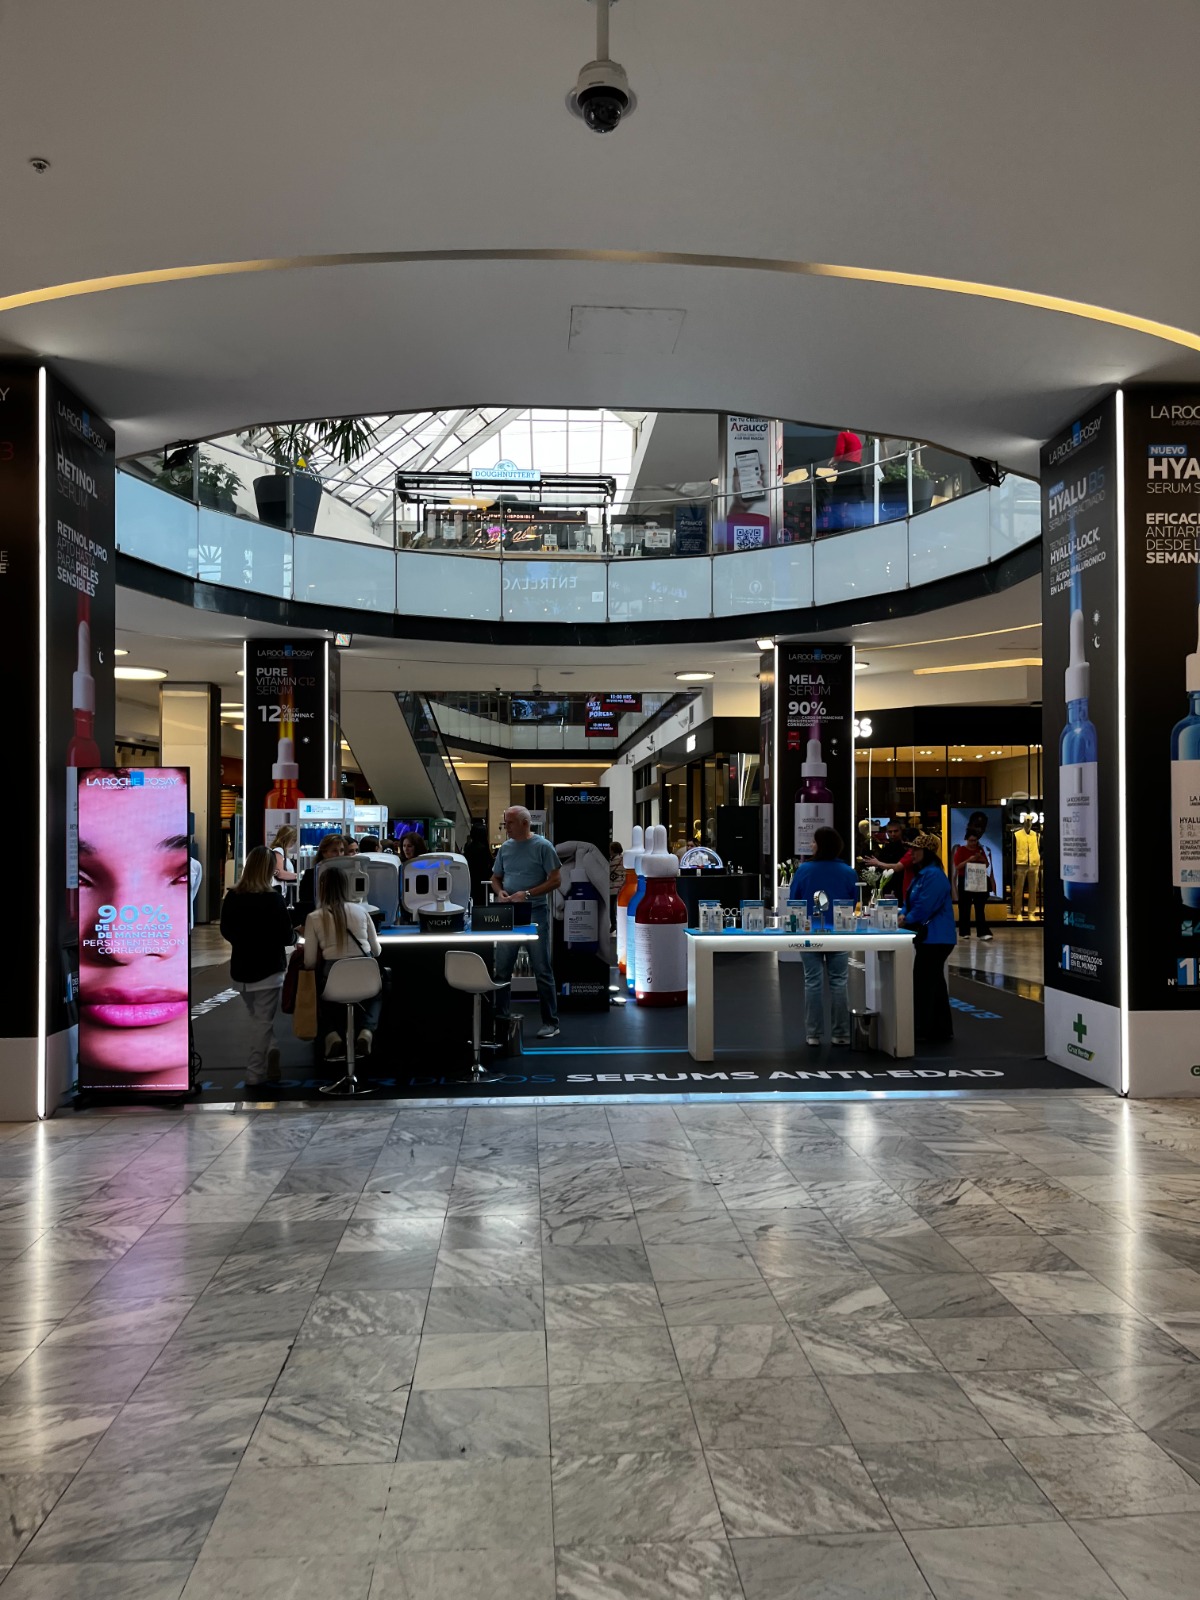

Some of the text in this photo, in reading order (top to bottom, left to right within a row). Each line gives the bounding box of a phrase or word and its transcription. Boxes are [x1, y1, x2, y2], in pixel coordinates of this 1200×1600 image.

[1150, 405, 1170, 418] LA
[1150, 446, 1185, 455] NUEVO
[57, 452, 98, 500] RETINOL
[475, 470, 535, 479] DOUGHNUTTERY
[1146, 482, 1192, 494] SERUM
[1049, 477, 1086, 519] HYALU
[57, 519, 88, 551] RETINOL
[1146, 539, 1191, 550] DESDE
[75, 562, 99, 585] PIELES
[57, 566, 95, 597] SENSIBLES
[256, 668, 288, 676] PURE
[256, 677, 297, 686] VITAMIN
[789, 674, 825, 685] MELA
[256, 686, 293, 696] SERUM
[789, 685, 831, 696] SERUM
[788, 701, 827, 716] 90%
[86, 777, 179, 786] LA ROCHE POSAY
[97, 904, 170, 924] 90%
[483, 915, 500, 923] VISIA
[136, 923, 173, 931] CASOS
[115, 931, 170, 939] MANCHAS
[83, 938, 185, 947] PERSISTENTES SON
[566, 1071, 760, 1082] SERUMS
[768, 1069, 1005, 1080] ANTI-EDAD
